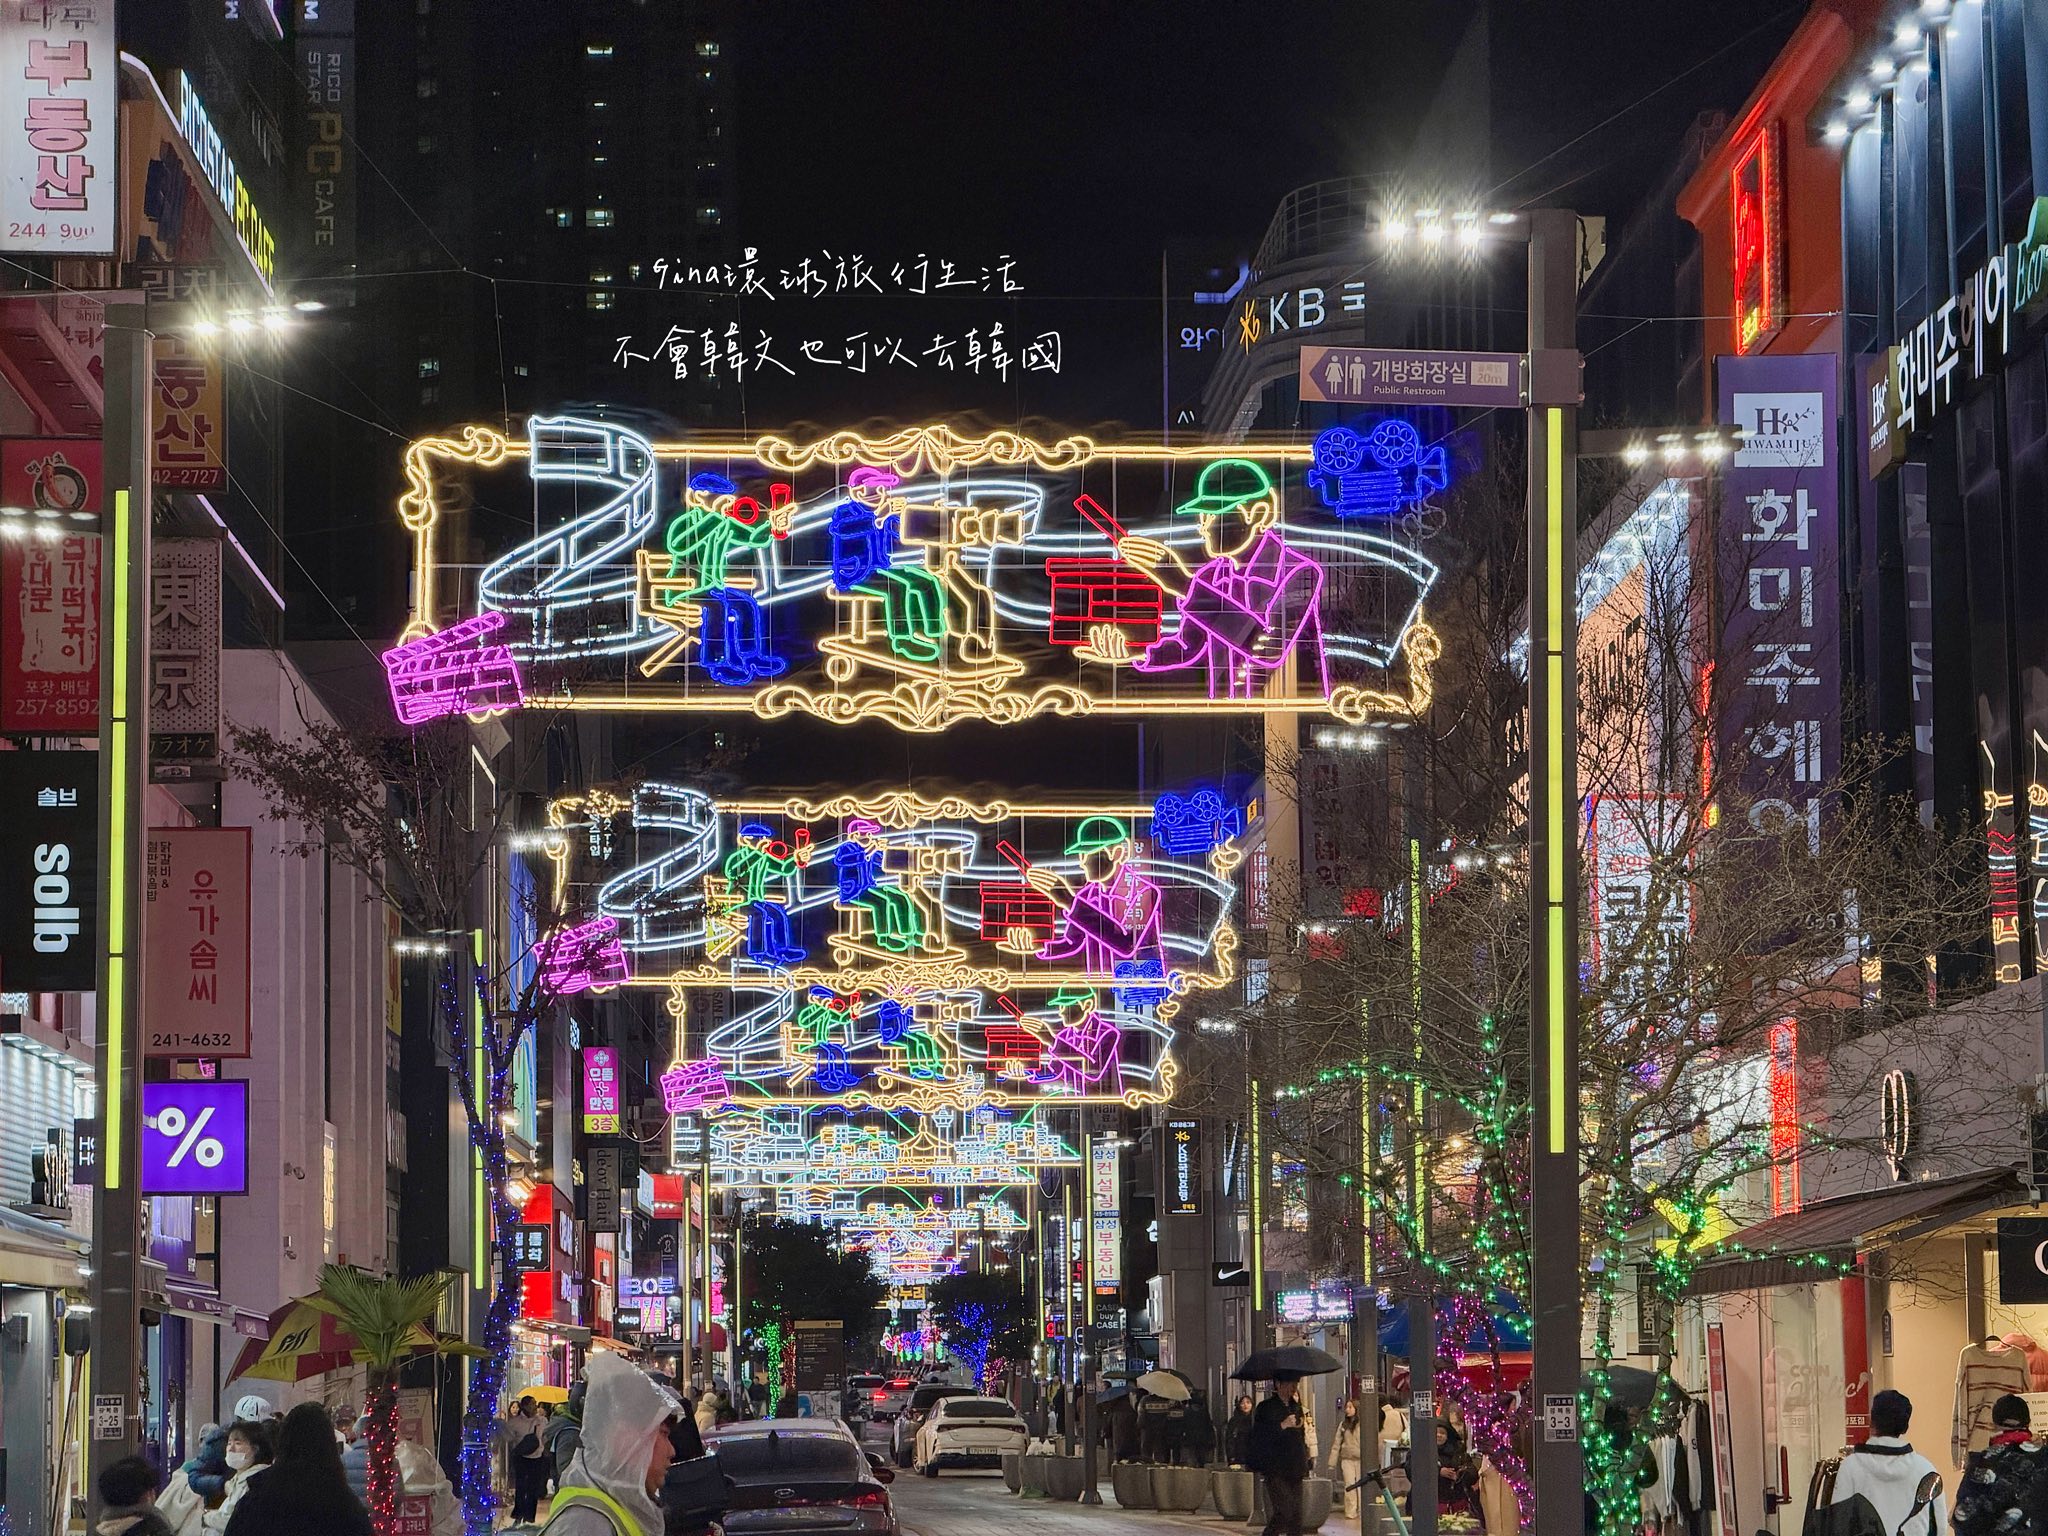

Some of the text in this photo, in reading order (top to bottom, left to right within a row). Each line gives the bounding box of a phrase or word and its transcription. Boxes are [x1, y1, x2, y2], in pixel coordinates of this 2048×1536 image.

[308, 51, 322, 104] STAR
[327, 53, 341, 102] RICO
[24, 40, 95, 211] 부동산
[304, 112, 342, 175] PC
[9, 223, 46, 238] 244
[314, 180, 335, 247] CAFE
[1269, 286, 1326, 334] KB
[1897, 242, 2009, 433] 화미주헤어
[1371, 359, 1468, 385] 개방화장실
[1476, 372, 1503, 384] 20m
[1373, 385, 1446, 397] Public Restroom
[1742, 439, 1812, 453] HWAMIJU
[33, 843, 80, 954] solb
[187, 869, 220, 1005] 유가솜씨
[152, 1033, 232, 1047] 241-4632
[1095, 1220, 1118, 1230] 삼성
[1097, 1231, 1115, 1279] 부동산
[1096, 1321, 1119, 1329] CASE
[98, 1415, 119, 1427] 3-25
[1550, 1415, 1571, 1429] 3-3
